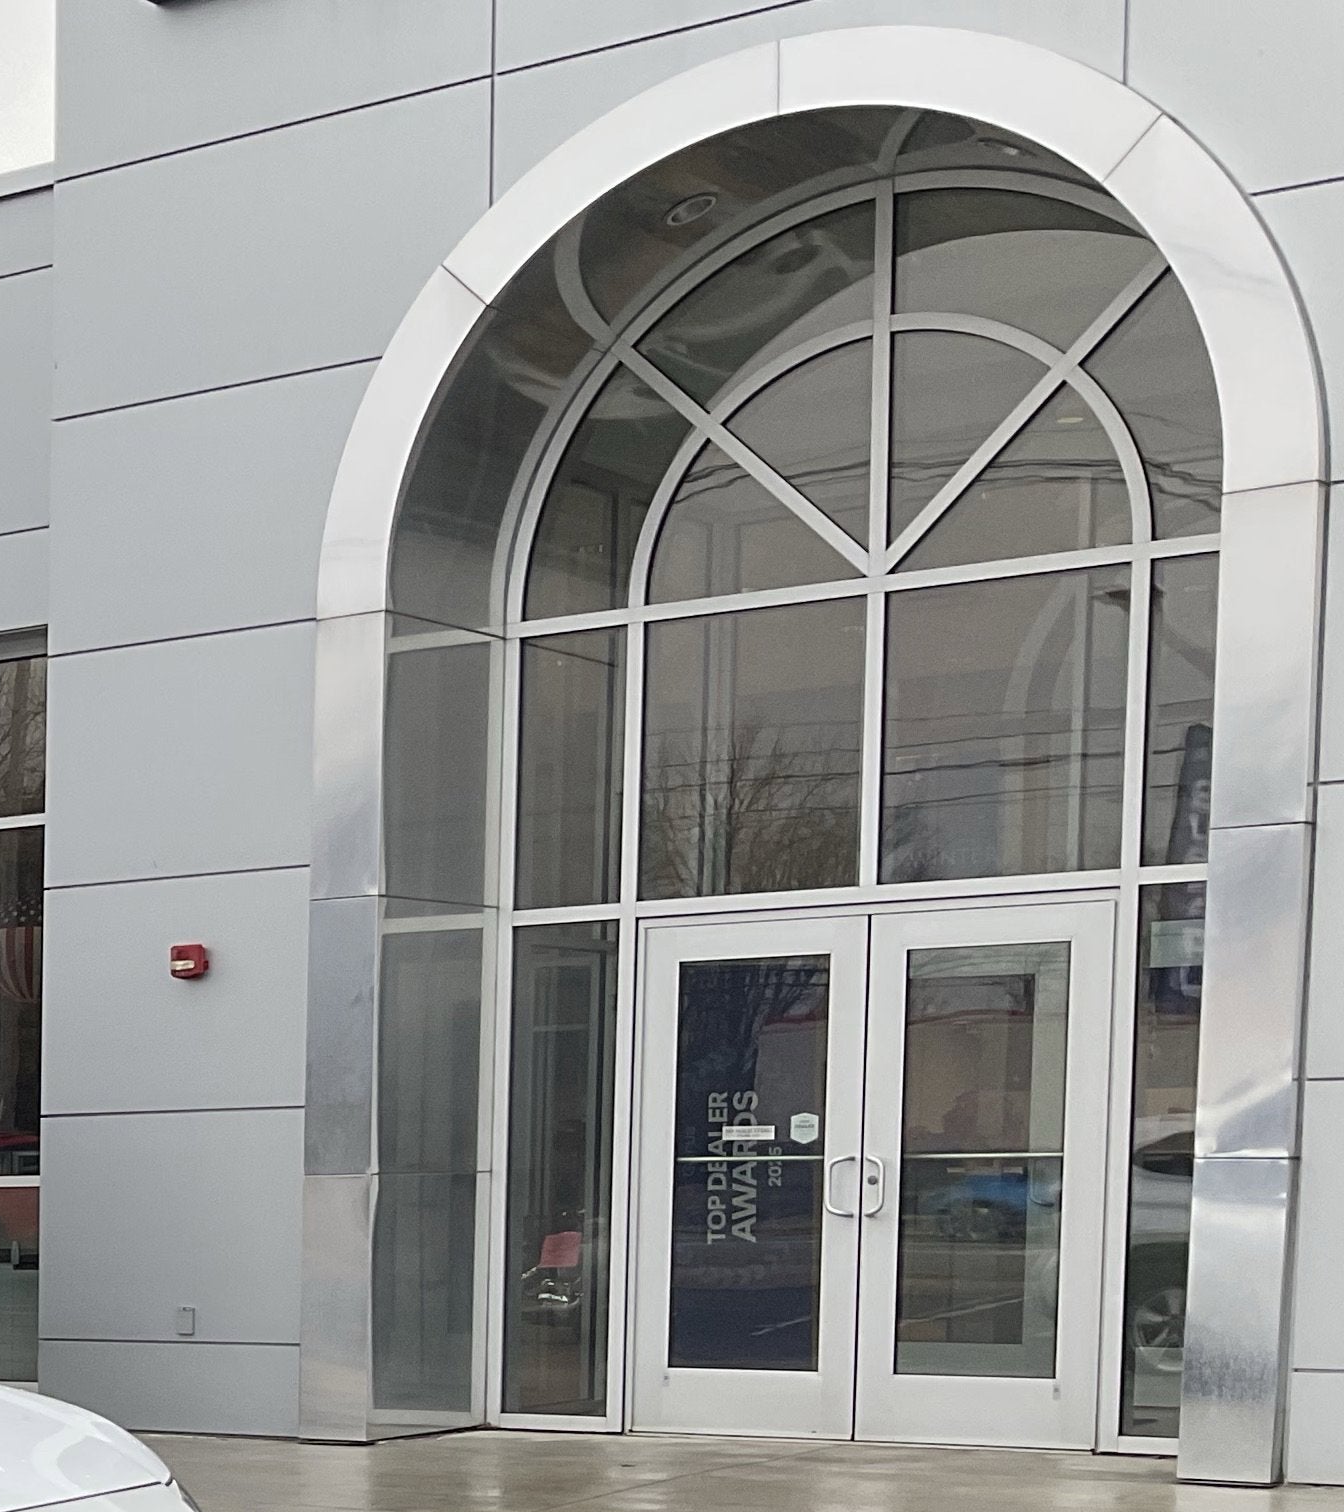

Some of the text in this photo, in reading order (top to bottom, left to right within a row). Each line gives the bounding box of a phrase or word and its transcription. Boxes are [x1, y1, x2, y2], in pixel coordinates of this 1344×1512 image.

[707, 1091, 728, 1245] TOP DEALER
[731, 1090, 759, 1244] AWARDS
